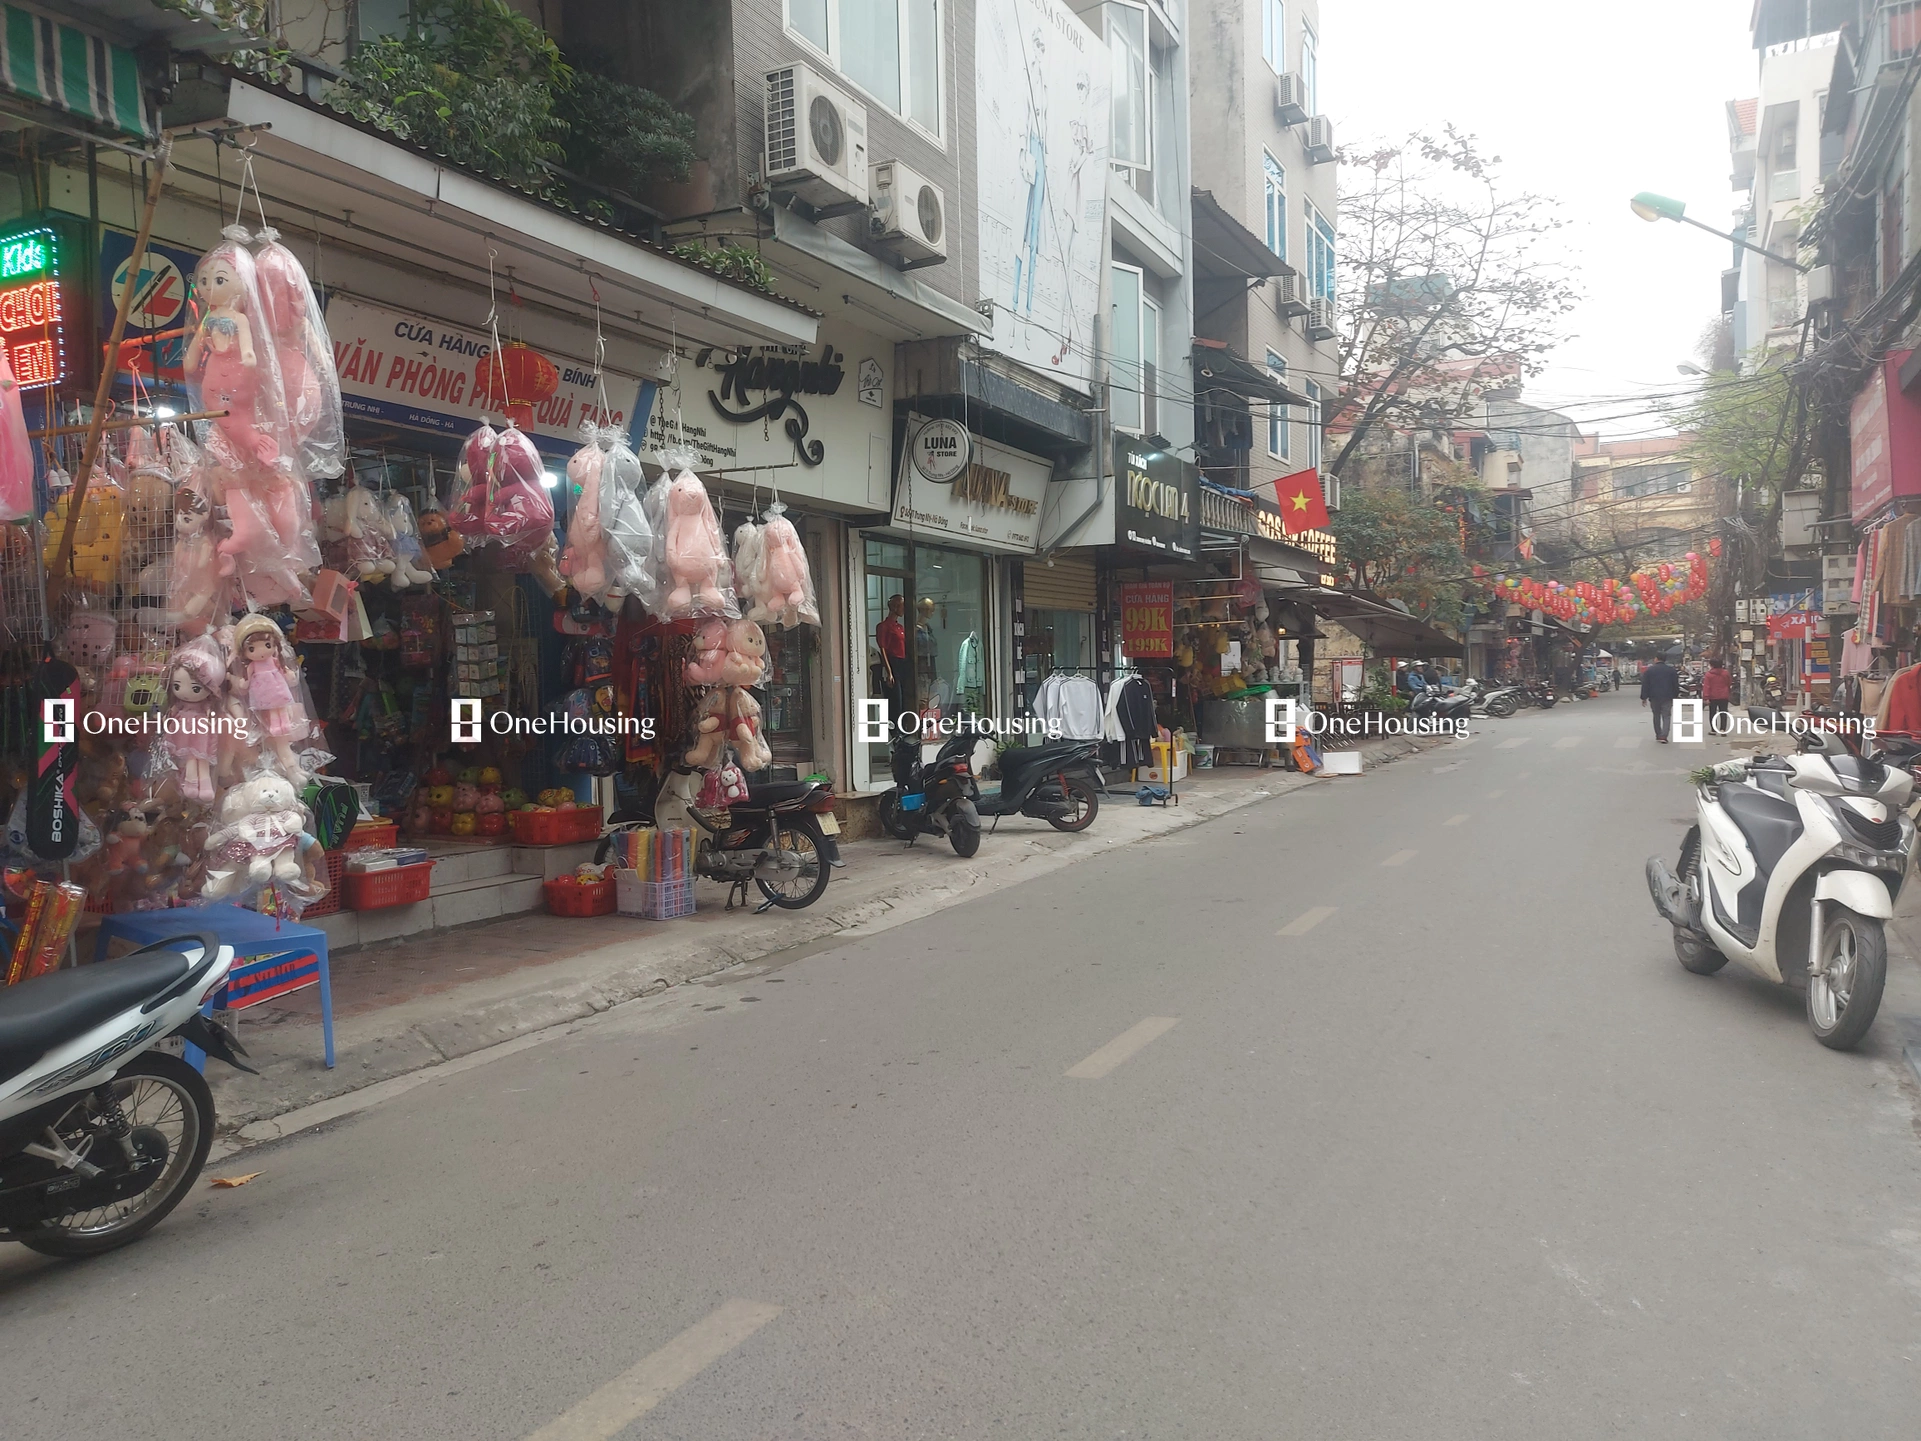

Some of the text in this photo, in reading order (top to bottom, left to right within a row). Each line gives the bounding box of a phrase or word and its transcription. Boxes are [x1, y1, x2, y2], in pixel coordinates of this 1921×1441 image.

[1056, 12, 1084, 53] STORE
[334, 337, 384, 385] VĂN
[385, 355, 467, 405] PHÒNG
[438, 332, 490, 359] HÀNG
[562, 367, 597, 389] BÍNH
[924, 436, 957, 450] LUNA
[1008, 494, 1038, 515] STORE
[1127, 470, 1159, 518] NGỌC
[1180, 492, 1190, 524] 4
[1300, 528, 1336, 564] COFFEE
[1125, 606, 1170, 632] 99K
[1127, 637, 1168, 652] 199K
[51, 773, 64, 843] BOSHIKA
